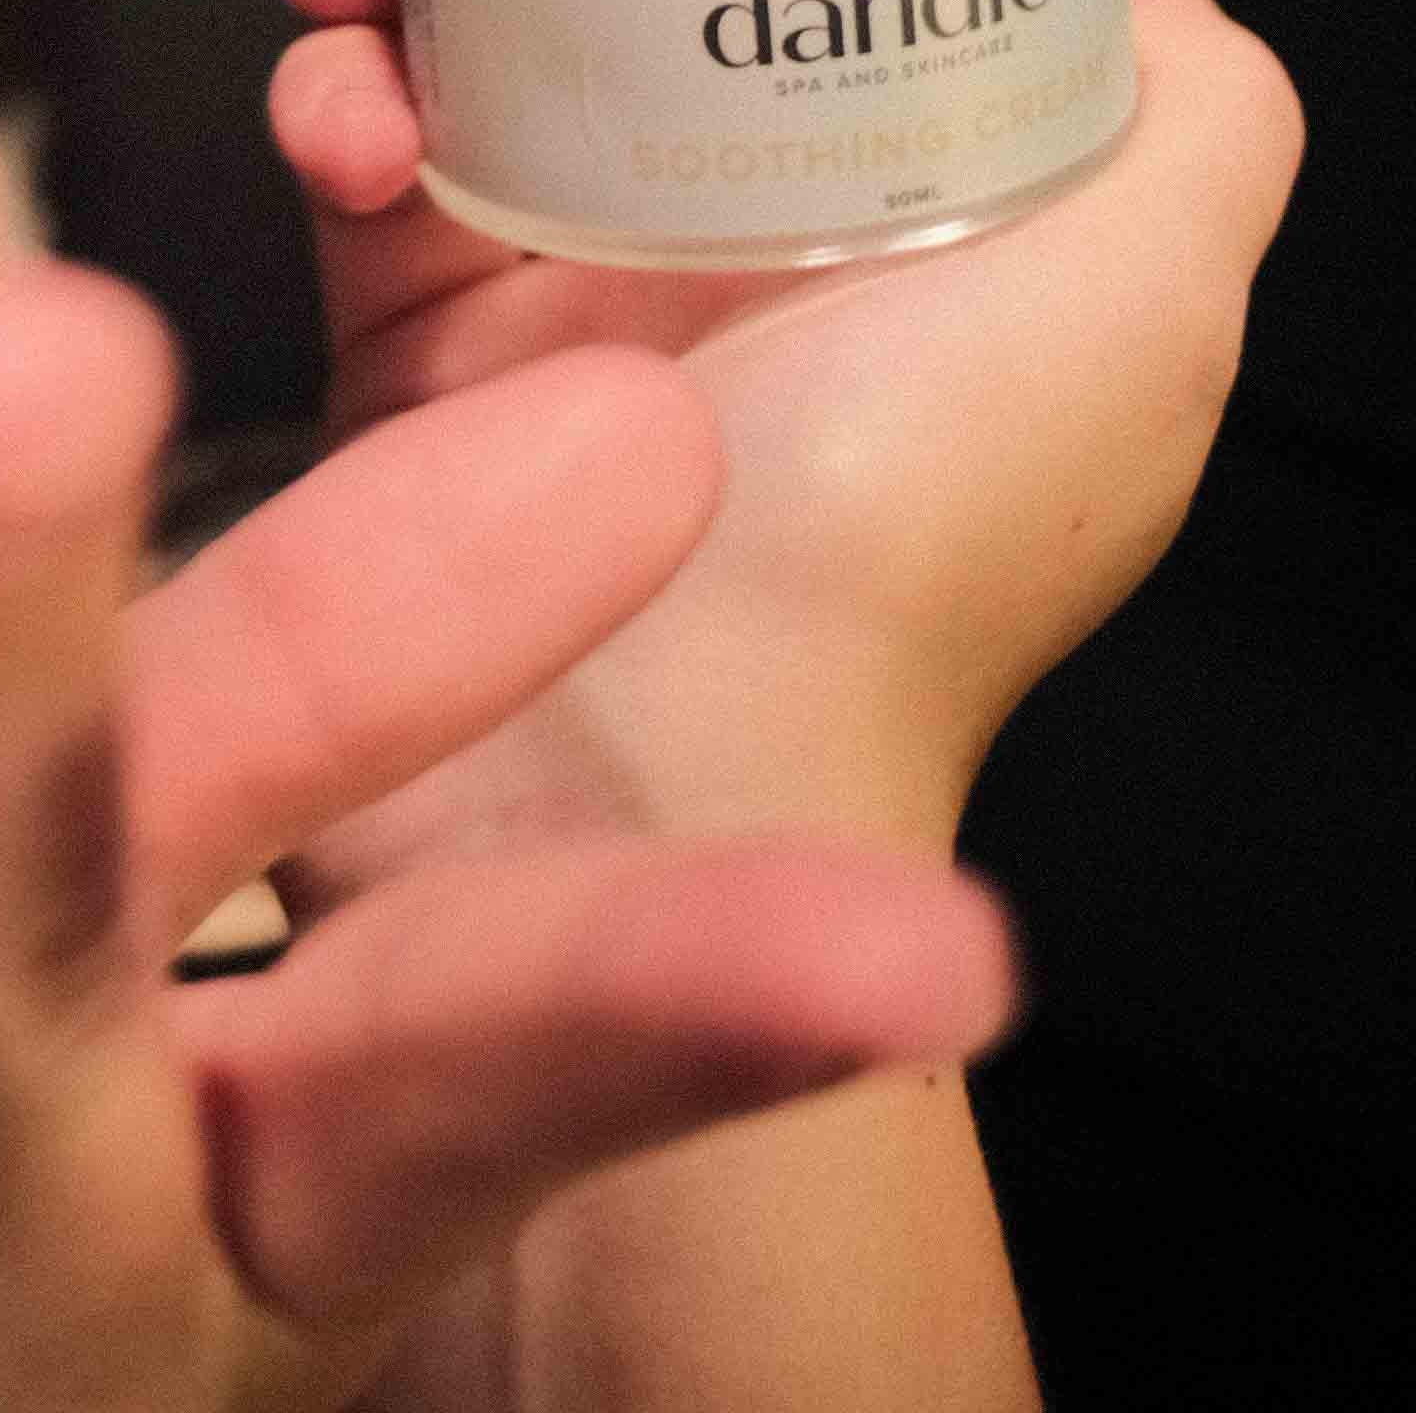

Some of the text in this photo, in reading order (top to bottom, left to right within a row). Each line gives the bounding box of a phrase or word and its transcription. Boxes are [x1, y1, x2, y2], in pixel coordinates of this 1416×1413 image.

[775, 34, 1014, 97] SPA AND SKINCARE
[632, 119, 952, 180] SOOTHING
